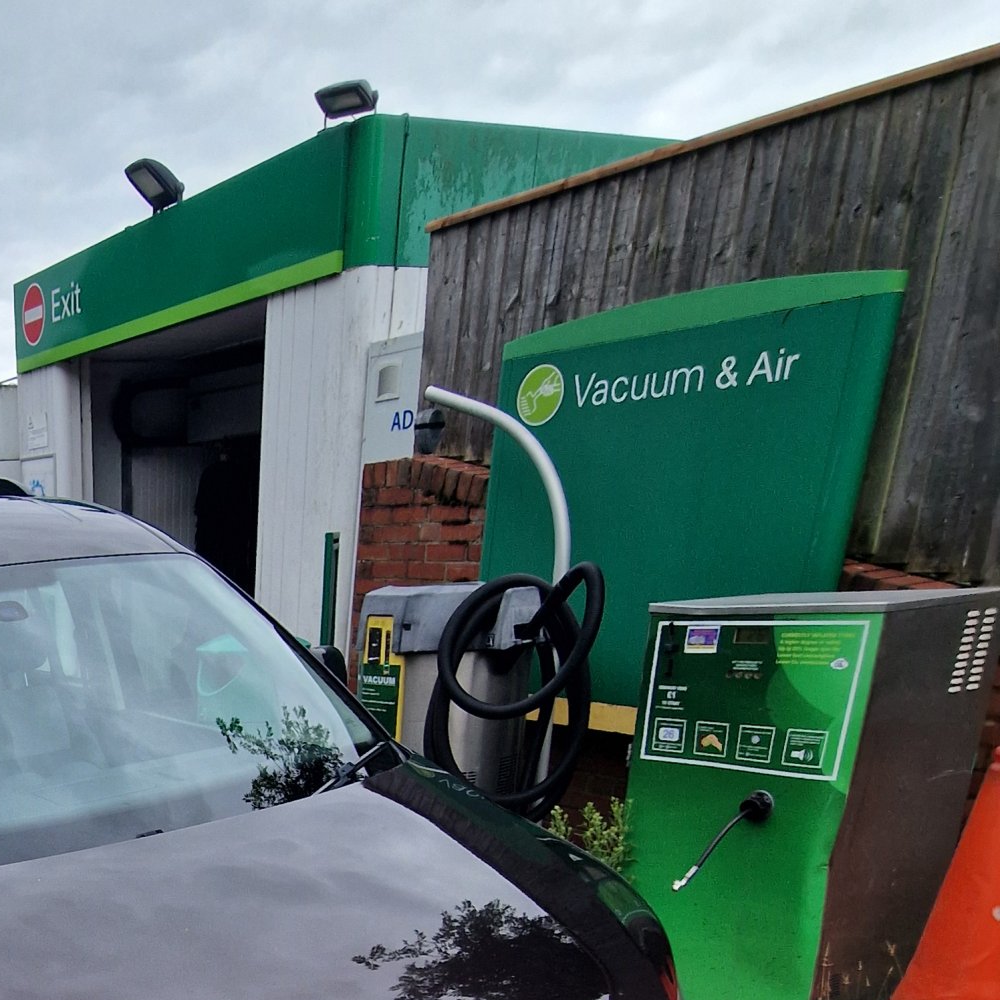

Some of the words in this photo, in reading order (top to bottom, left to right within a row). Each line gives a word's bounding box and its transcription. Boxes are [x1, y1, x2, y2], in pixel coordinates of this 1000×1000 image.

[51, 281, 82, 323] Exit
[574, 364, 705, 408] Vacuum
[715, 355, 738, 390] &
[746, 347, 800, 386] Air
[391, 409, 414, 432] AD
[363, 675, 396, 685] VACUUM
